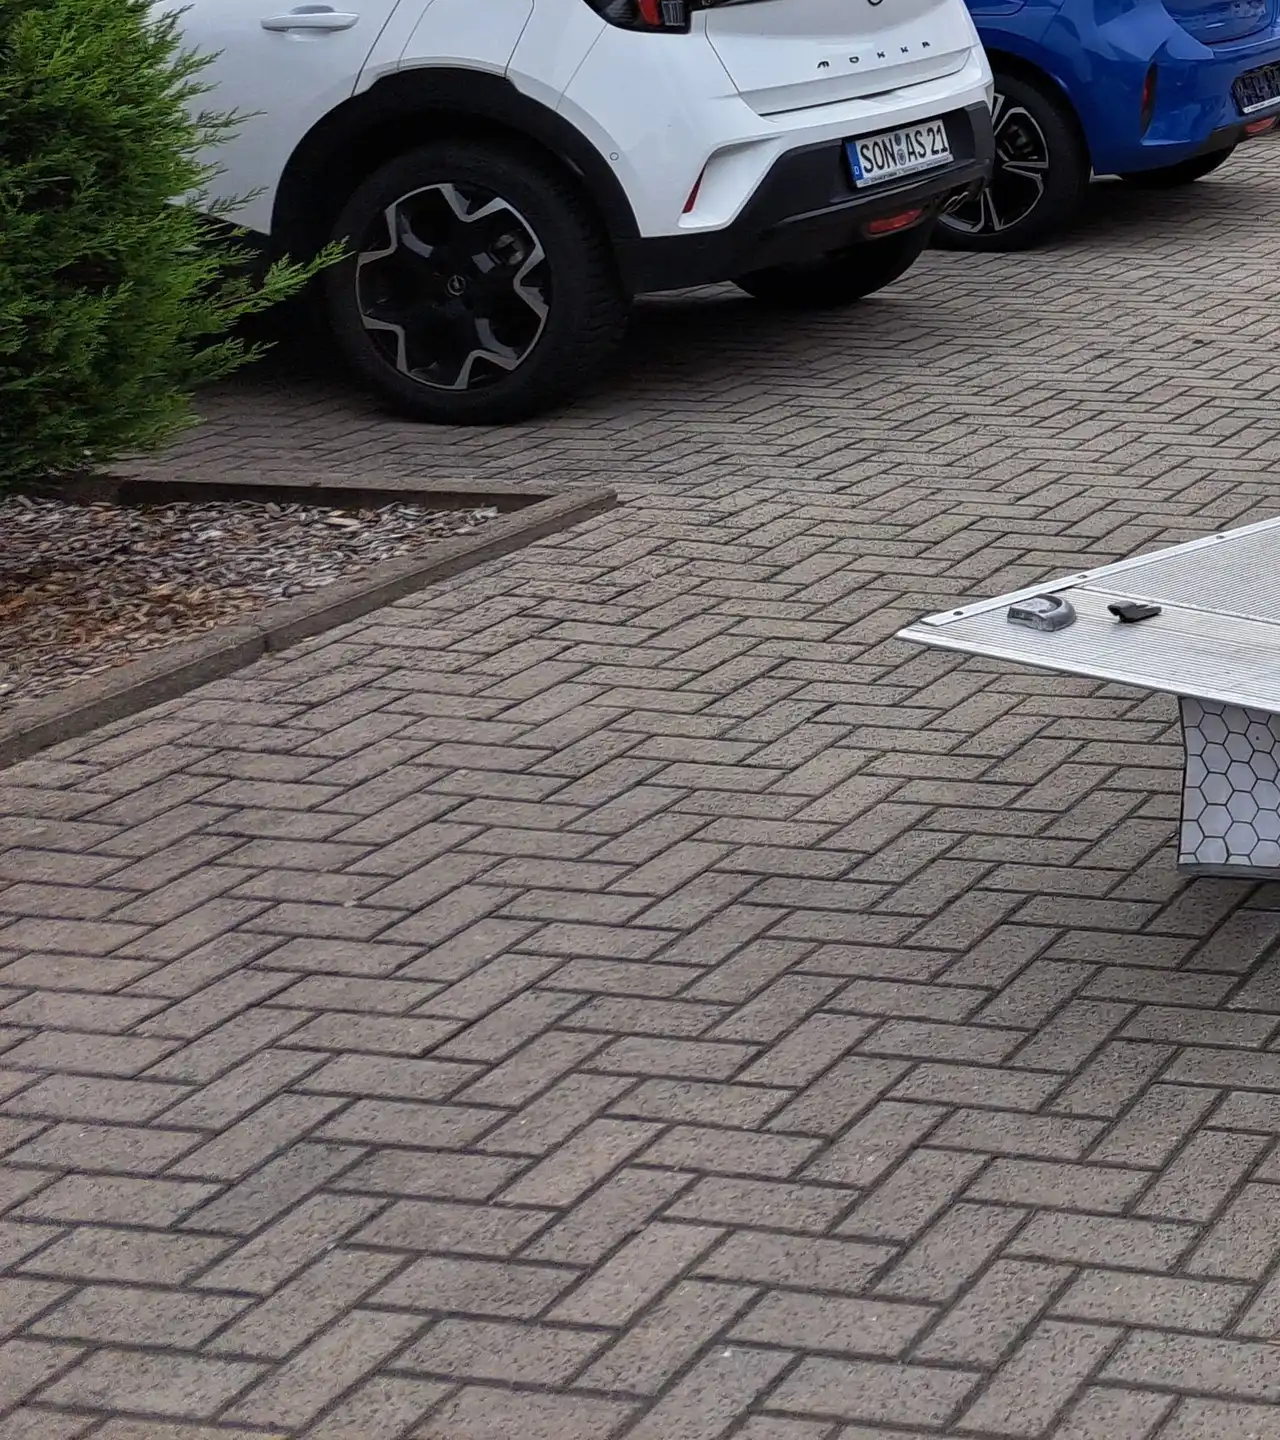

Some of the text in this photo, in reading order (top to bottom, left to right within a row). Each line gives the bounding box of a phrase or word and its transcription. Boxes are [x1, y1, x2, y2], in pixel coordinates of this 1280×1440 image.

[817, 41, 931, 69] MOKKA
[860, 138, 897, 173] SON
[905, 130, 927, 162] AS
[927, 124, 949, 156] 21
